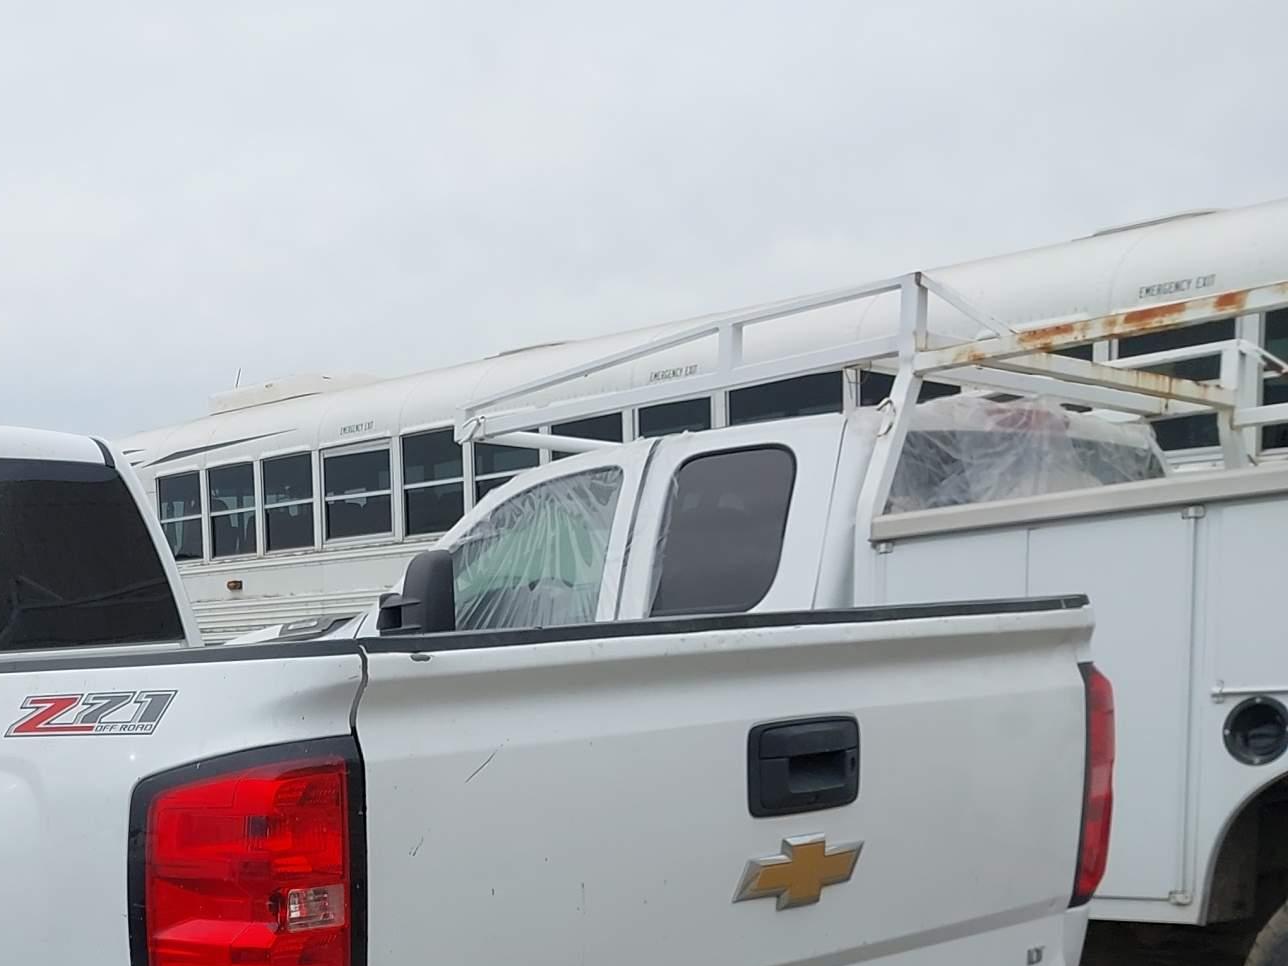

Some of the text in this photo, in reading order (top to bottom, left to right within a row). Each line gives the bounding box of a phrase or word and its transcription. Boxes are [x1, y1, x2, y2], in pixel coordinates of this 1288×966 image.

[1139, 273, 1216, 299] EMERGENCY EXIT
[4, 690, 178, 737] Z71
[95, 723, 153, 732] OFF ROAD
